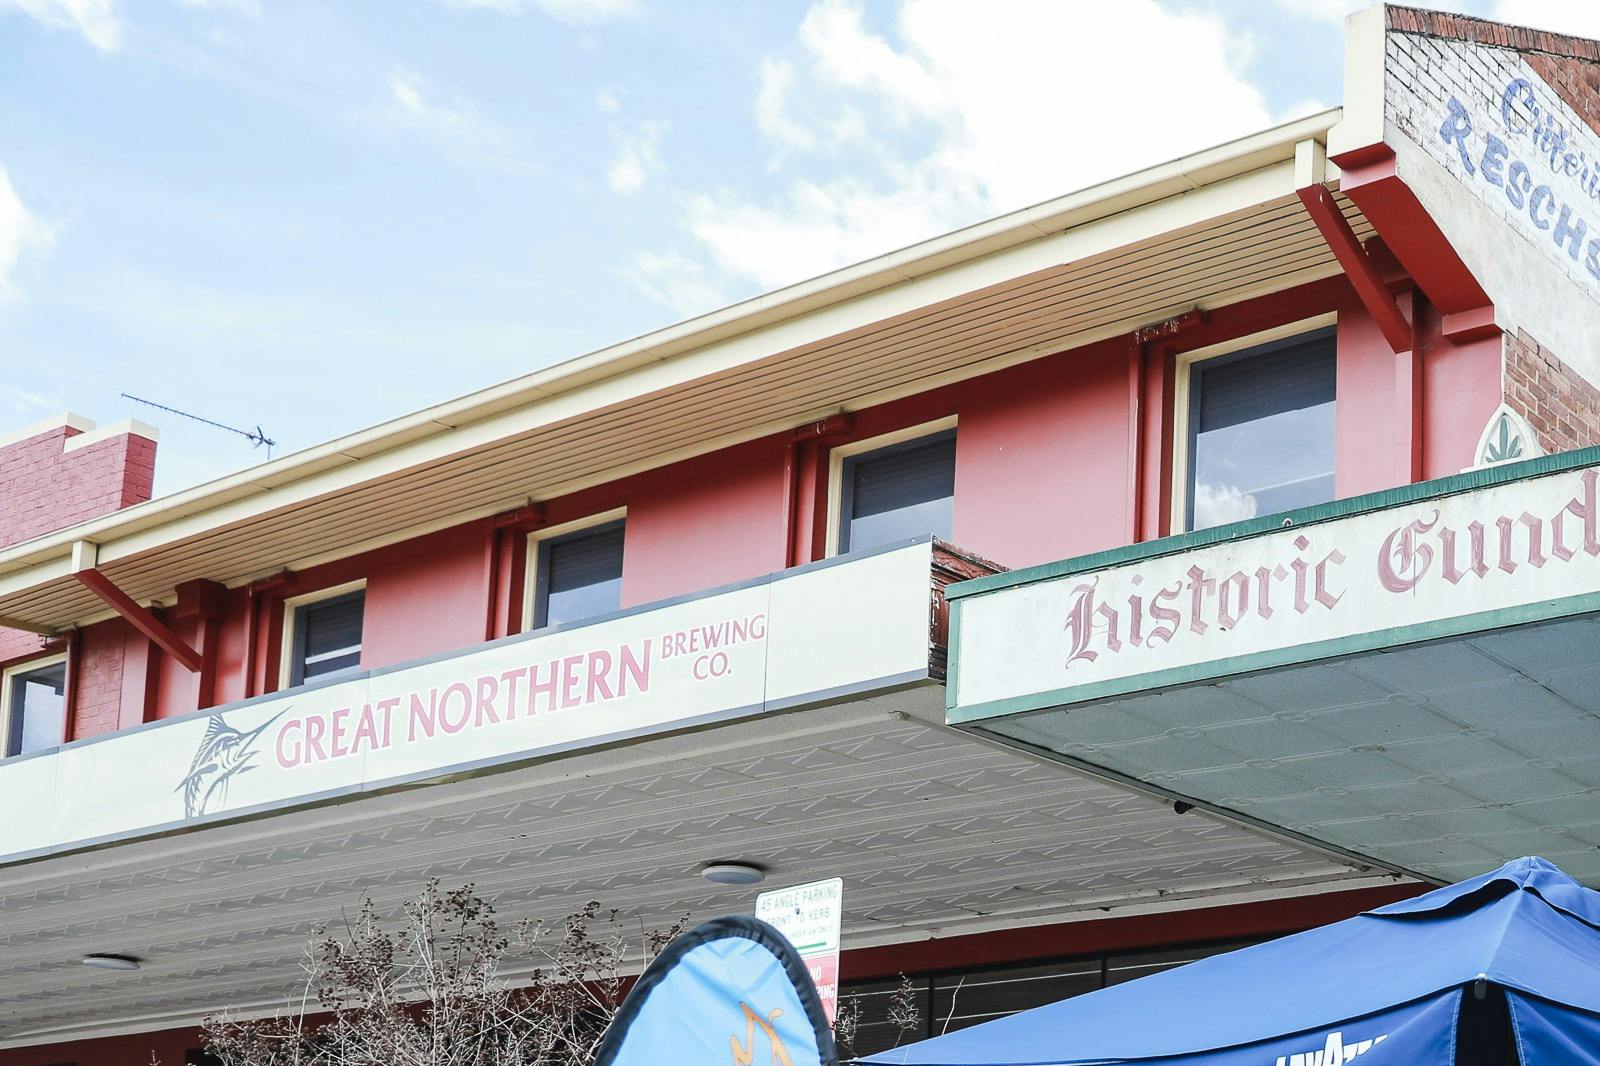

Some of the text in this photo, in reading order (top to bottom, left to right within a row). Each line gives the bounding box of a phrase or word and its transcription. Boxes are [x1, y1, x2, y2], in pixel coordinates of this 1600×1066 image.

[692, 653, 733, 682] CO.
[275, 613, 767, 770] GREAT NORTHERN BREWING
[802, 884, 838, 903] PARKING
[808, 907, 830, 921] KERB
